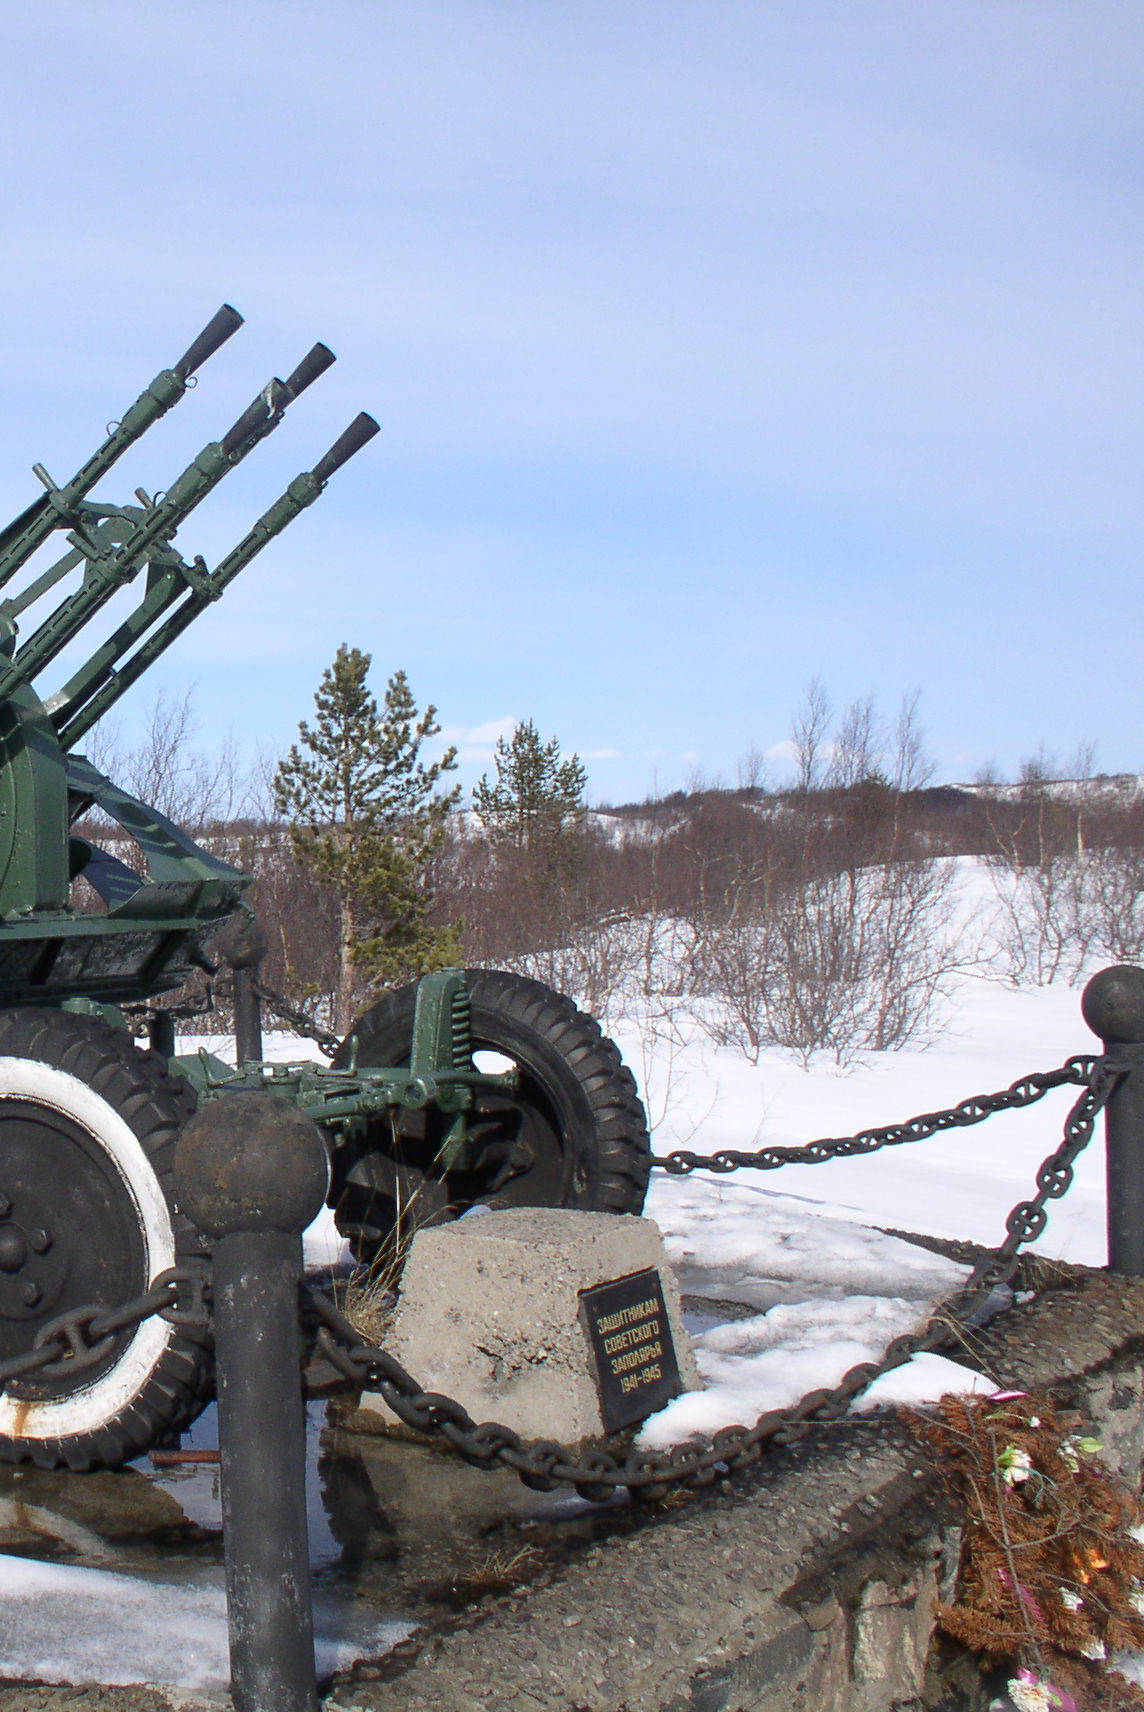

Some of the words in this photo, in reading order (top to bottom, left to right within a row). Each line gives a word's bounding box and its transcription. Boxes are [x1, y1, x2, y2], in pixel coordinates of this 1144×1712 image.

[604, 1320, 660, 1354] СОВЕТСКОГО
[611, 1342, 663, 1375] ЗАПОЛЯРЬЯ
[621, 1364, 662, 1393] 1941-1945
